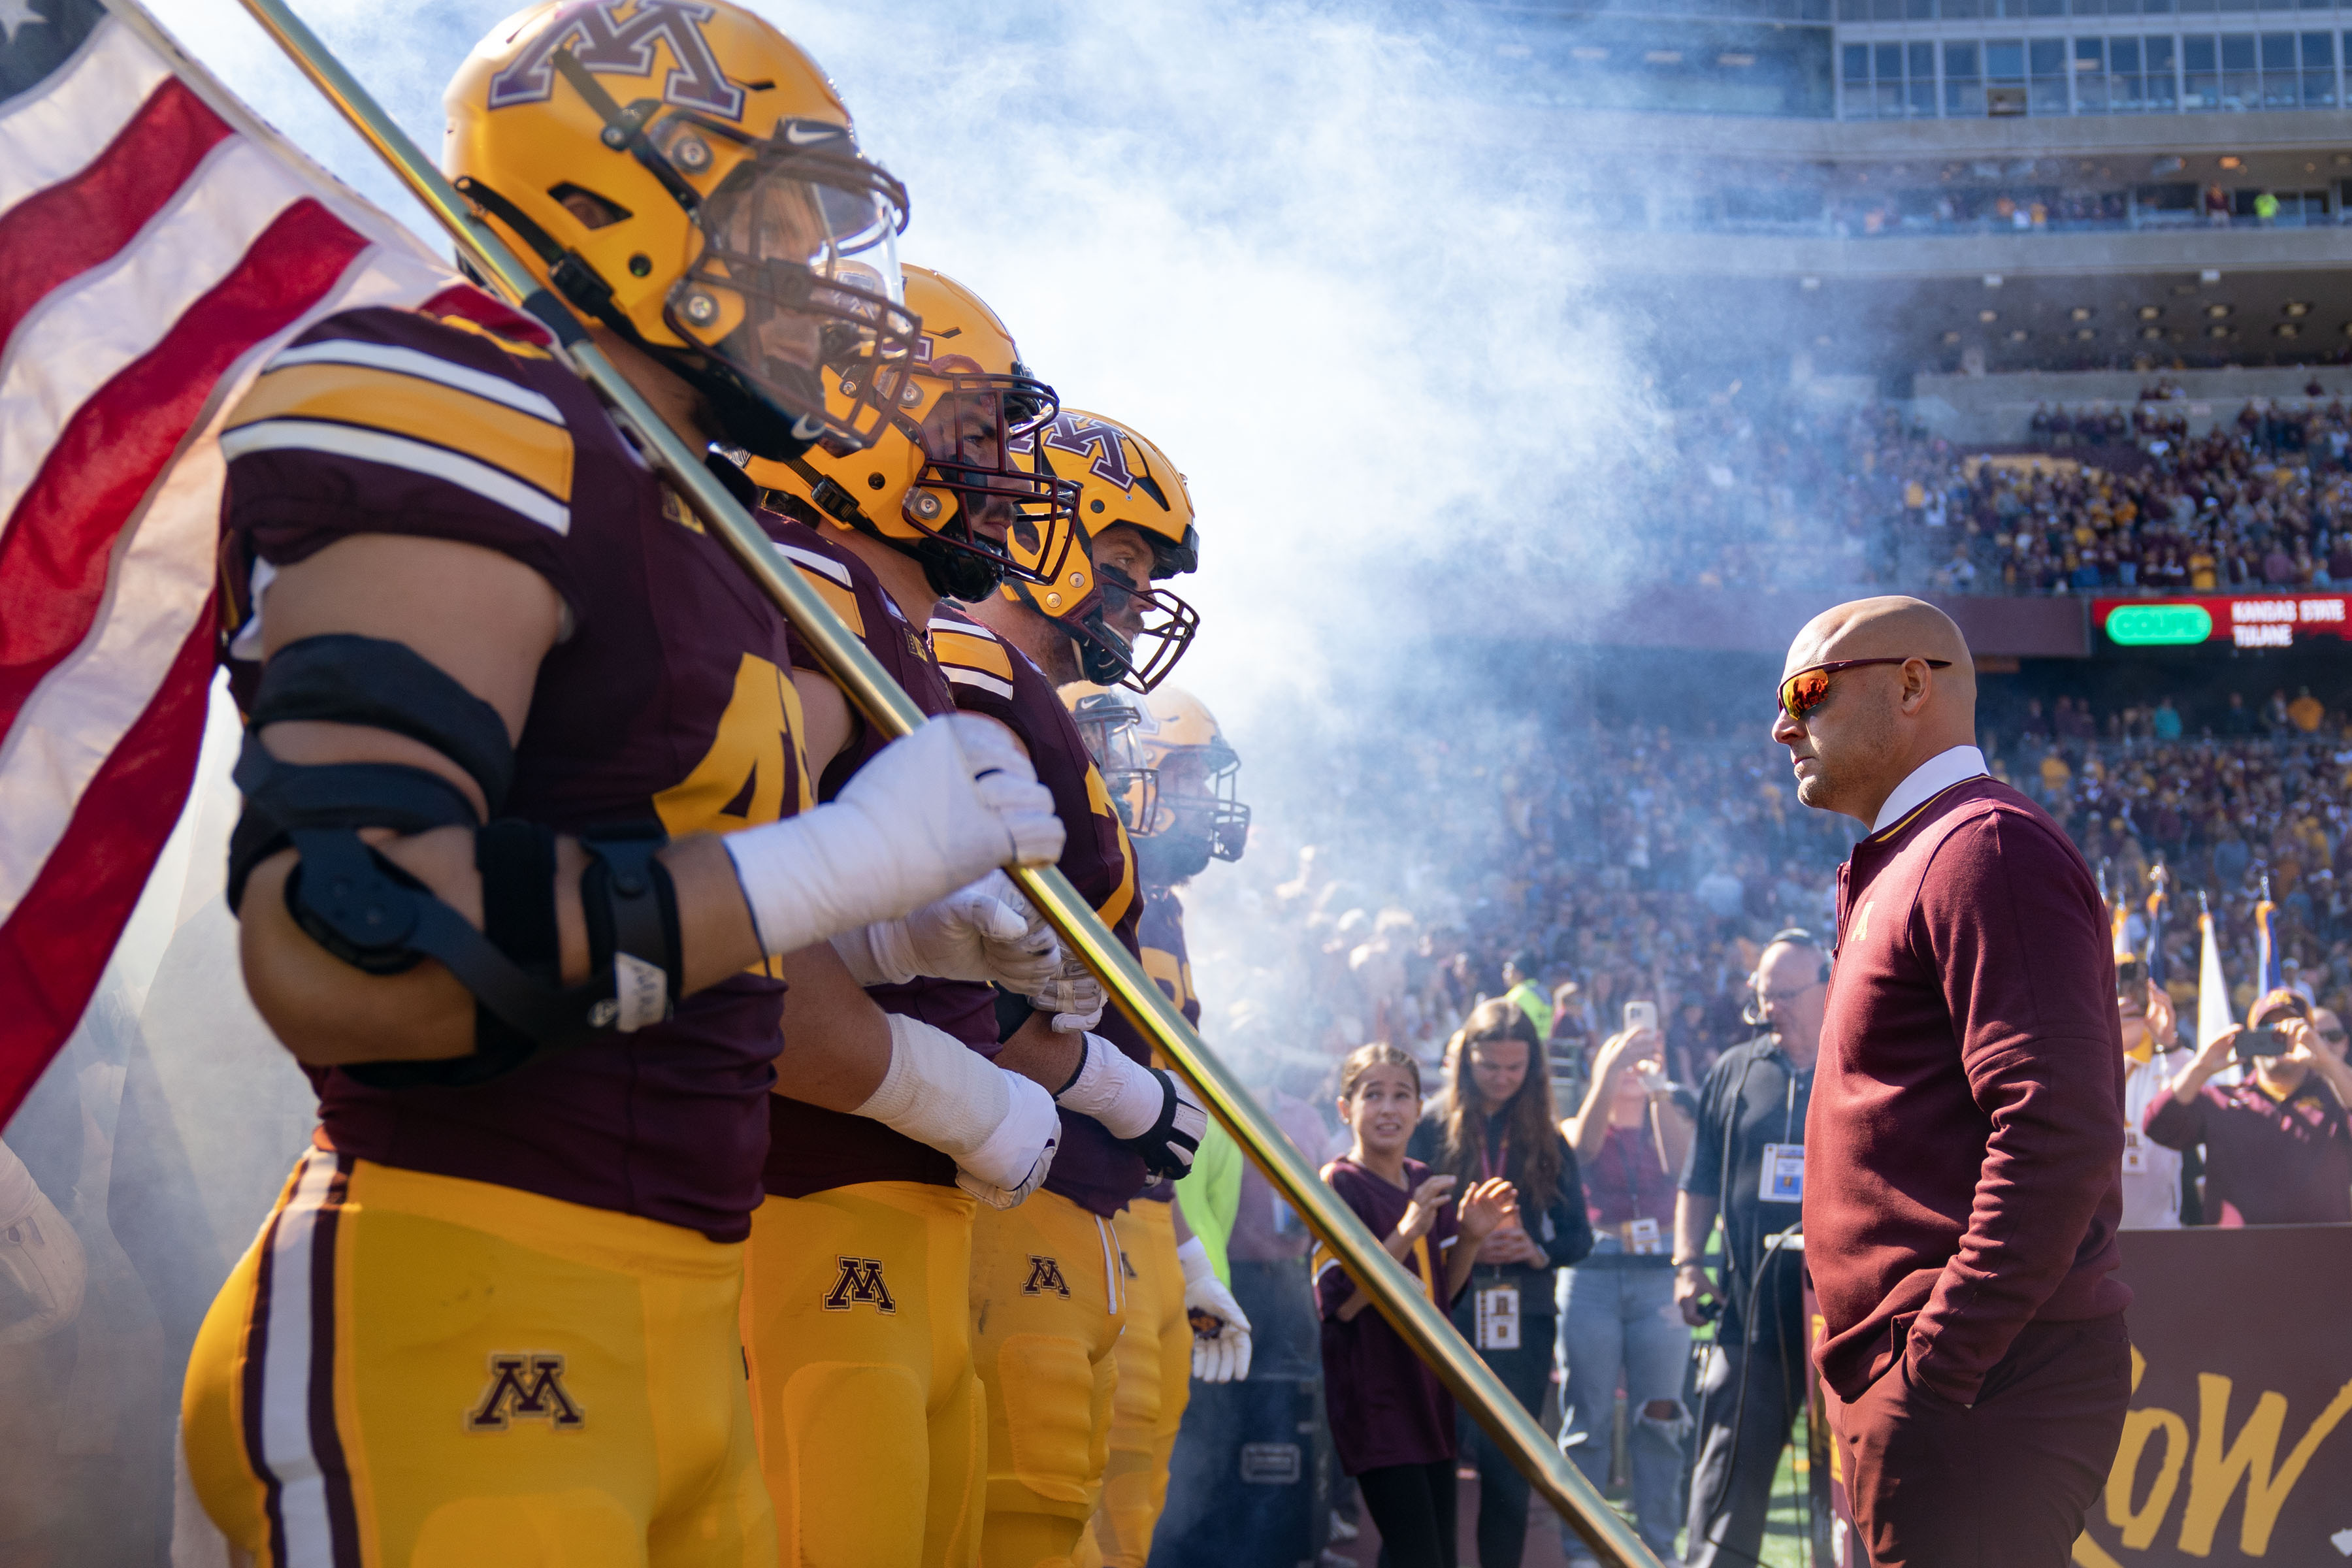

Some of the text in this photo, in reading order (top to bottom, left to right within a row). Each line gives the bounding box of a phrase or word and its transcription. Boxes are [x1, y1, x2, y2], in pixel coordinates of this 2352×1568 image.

[488, 0, 746, 122] M
[2232, 598, 2346, 623] KANSAS STATE
[2232, 623, 2294, 648] TULANE
[822, 1254, 897, 1316] M
[1021, 1253, 1071, 1299] M
[464, 1351, 585, 1432] M
